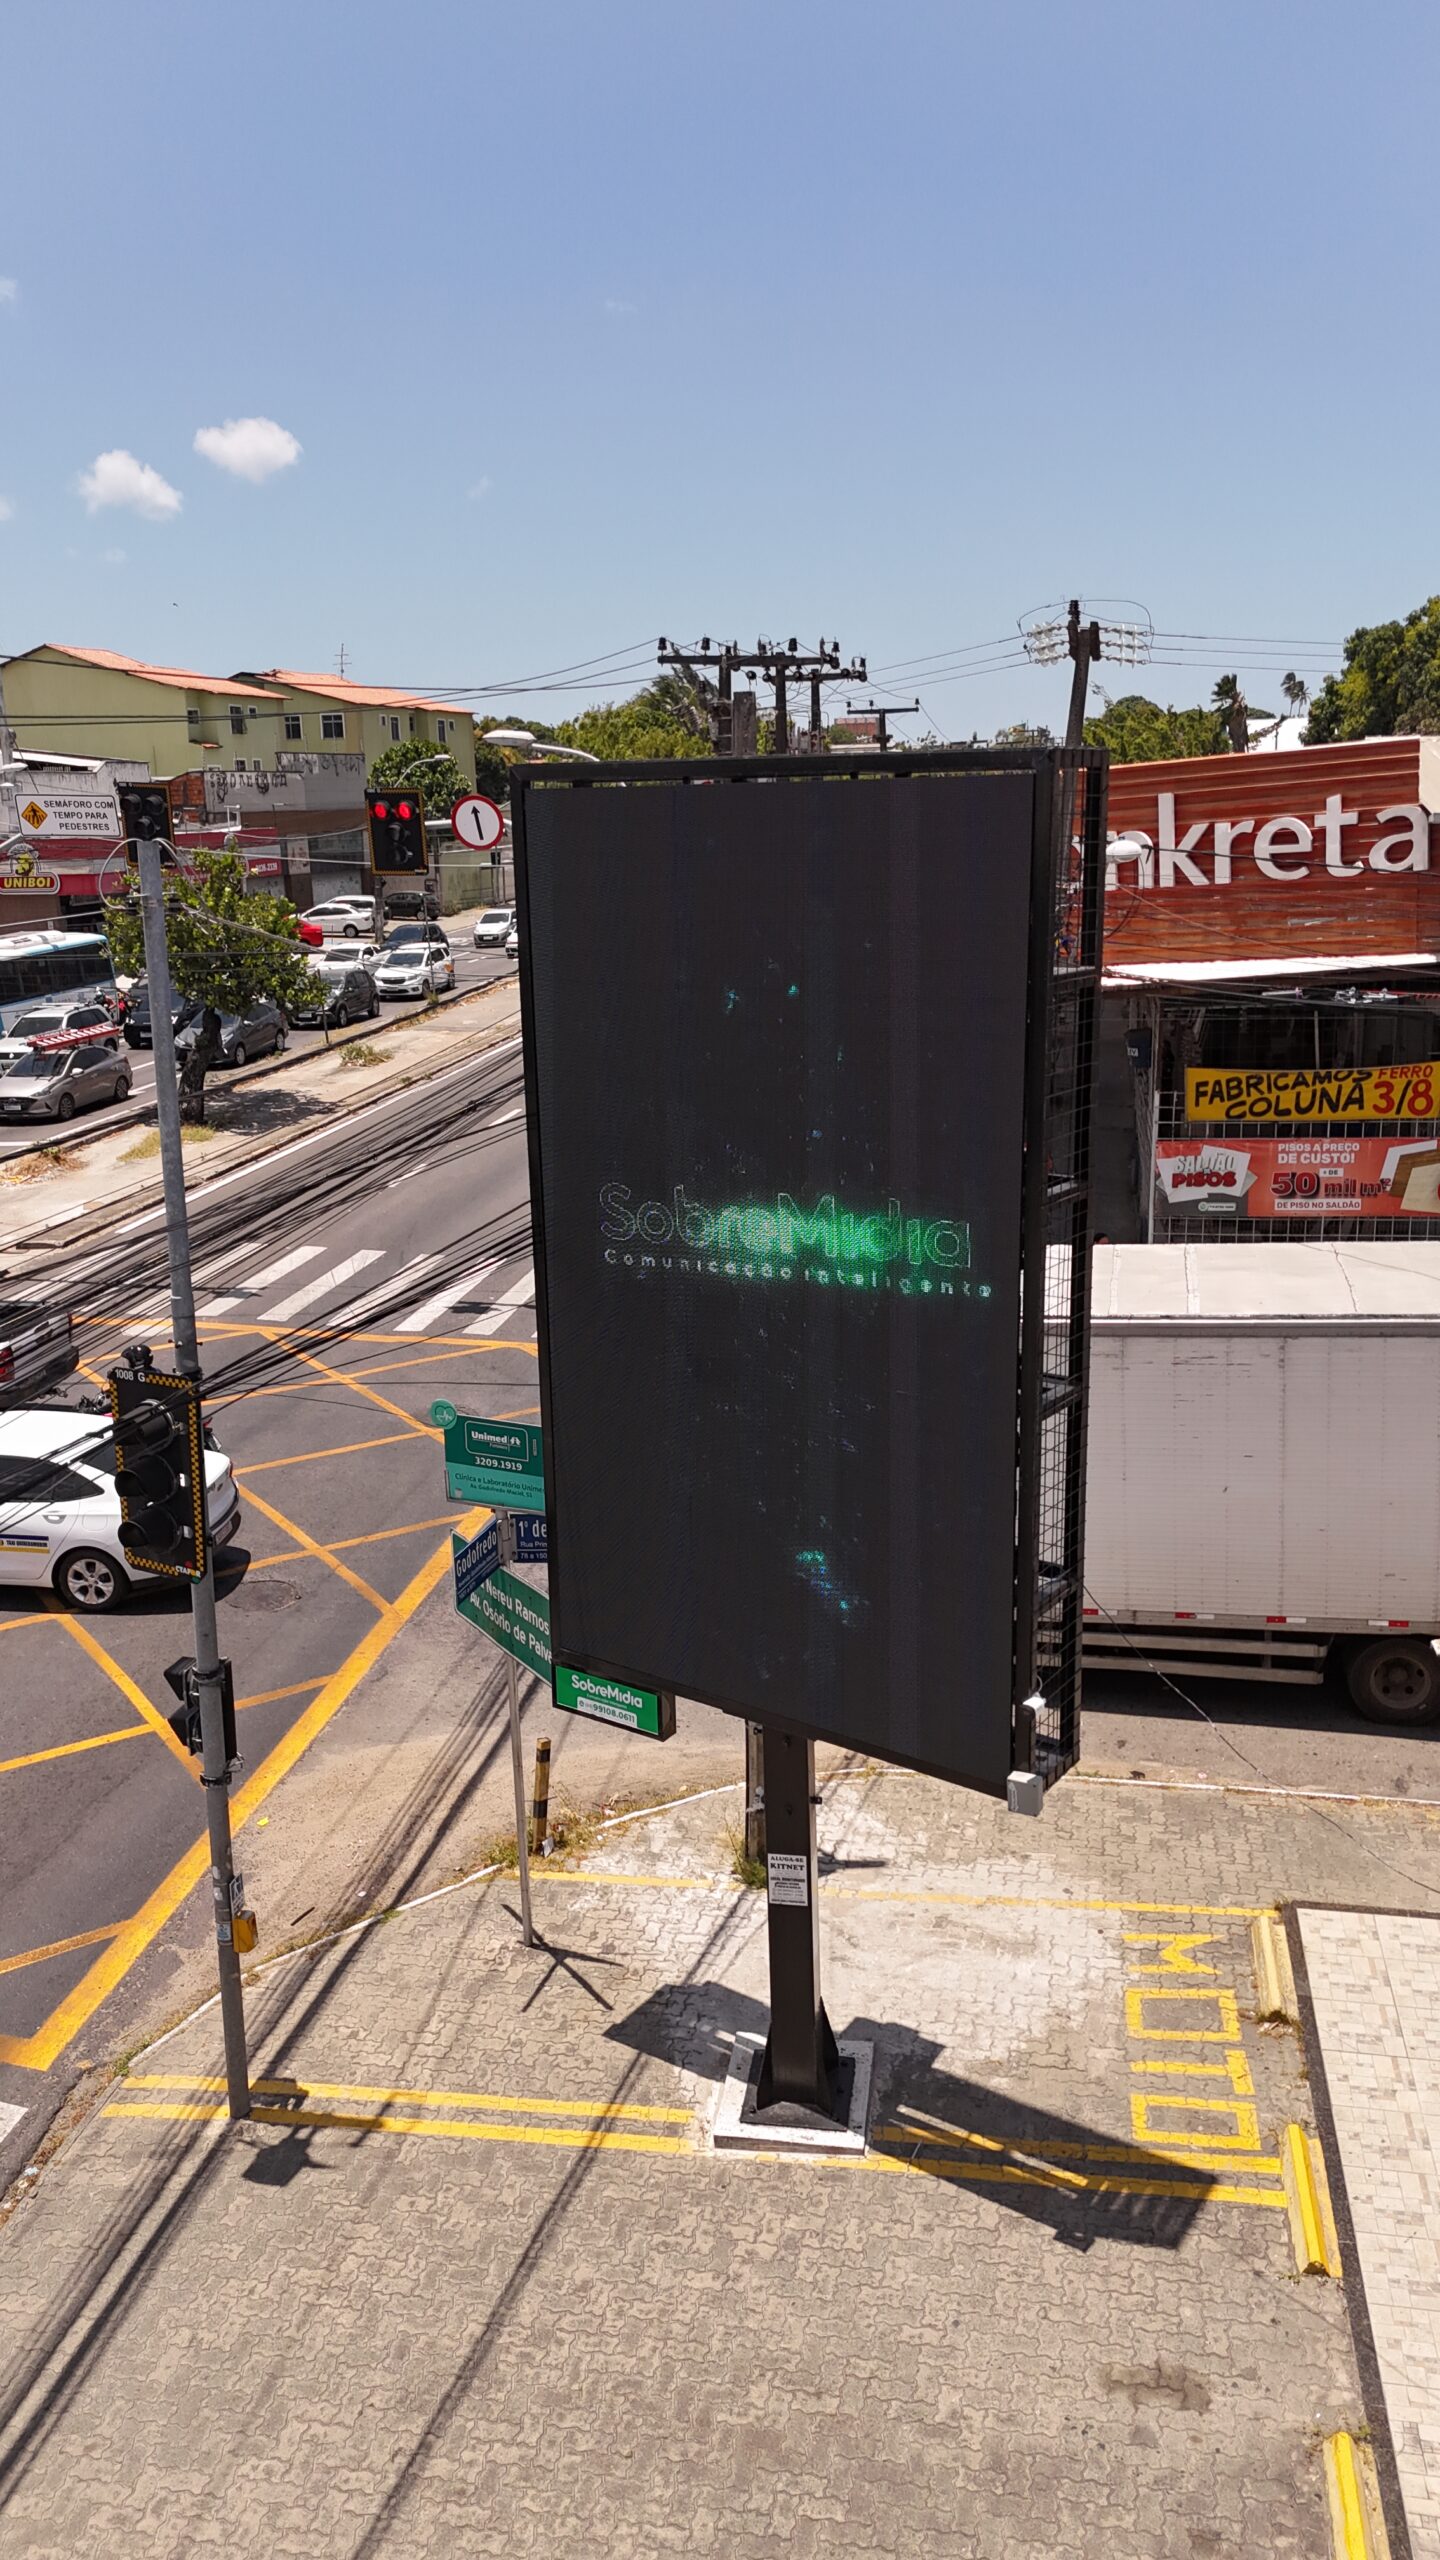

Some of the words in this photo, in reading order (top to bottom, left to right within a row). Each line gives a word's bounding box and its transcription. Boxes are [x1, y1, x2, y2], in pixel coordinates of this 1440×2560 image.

[44, 800, 92, 808] SEMÁFORO
[53, 811, 82, 819] TEMPO
[85, 812, 108, 820] PARA
[59, 822, 110, 831] PEDESTRES
[1067, 793, 1429, 891] nkreta
[4, 877, 51, 888] UNIBOI
[1377, 1065, 1433, 1079] FERRO
[1195, 1069, 1373, 1107] FABRICAMOS
[1225, 1082, 1365, 1119] COLUNA
[1373, 1079, 1434, 1116] 3/8
[1278, 1143, 1311, 1151] PISOS
[1323, 1142, 1360, 1153] PREÇO
[1278, 1154, 1297, 1164] DE
[1172, 1171, 1237, 1188] PISOS
[1271, 1172, 1320, 1196] 50
[1324, 1179, 1357, 1197] mil
[1326, 1200, 1360, 1208] SALDÃO
[114, 1368, 134, 1380] 1008
[137, 1371, 146, 1382] G
[471, 1430, 508, 1444] Unimed
[474, 1456, 522, 1471] 3209.1919
[455, 1473, 476, 1482] Clínica
[483, 1478, 520, 1489] Laboratório
[522, 1484, 544, 1492] Unime
[532, 1520, 548, 1538] de
[456, 1530, 497, 1577] Godofredo
[486, 1579, 513, 1610] Nereu
[515, 1598, 550, 1636] Ramos
[483, 1600, 511, 1634] Osório
[514, 1624, 526, 1645] de
[571, 1674, 643, 1709] SobreMidia
[593, 1704, 635, 1724] 99108.0611
[770, 1862, 805, 1871] KITNET
[1122, 1933, 1262, 2150] MOTO
